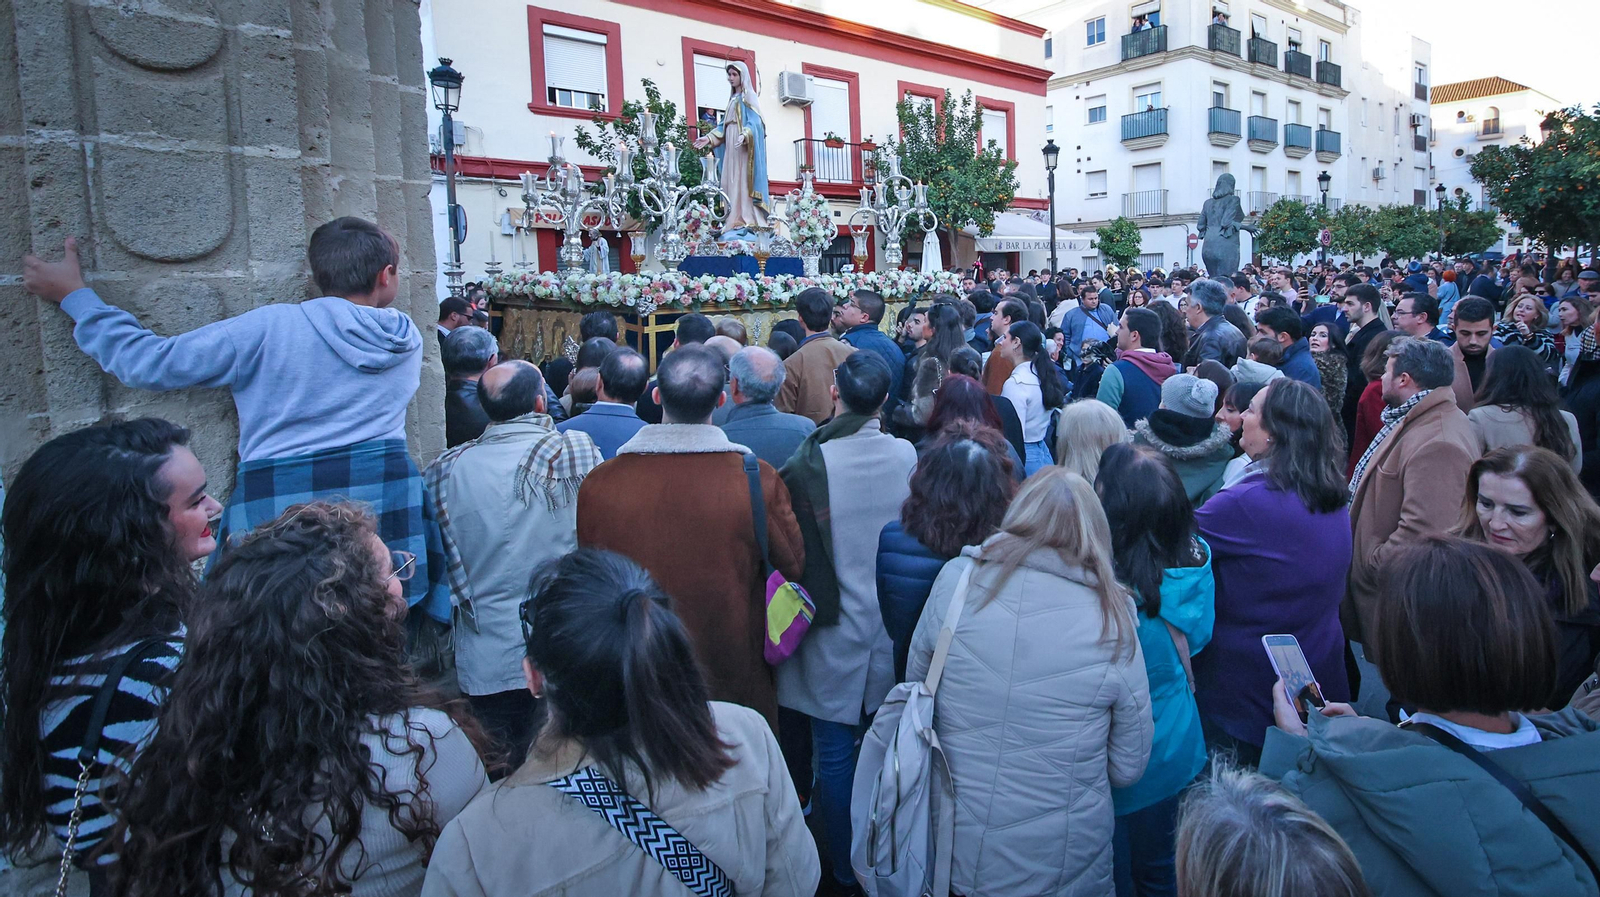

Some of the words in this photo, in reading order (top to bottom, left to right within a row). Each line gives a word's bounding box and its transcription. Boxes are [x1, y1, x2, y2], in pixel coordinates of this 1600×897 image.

[1005, 241, 1020, 250] BAR
[1022, 241, 1032, 250] LA
[1034, 241, 1067, 250] PLAZELA
